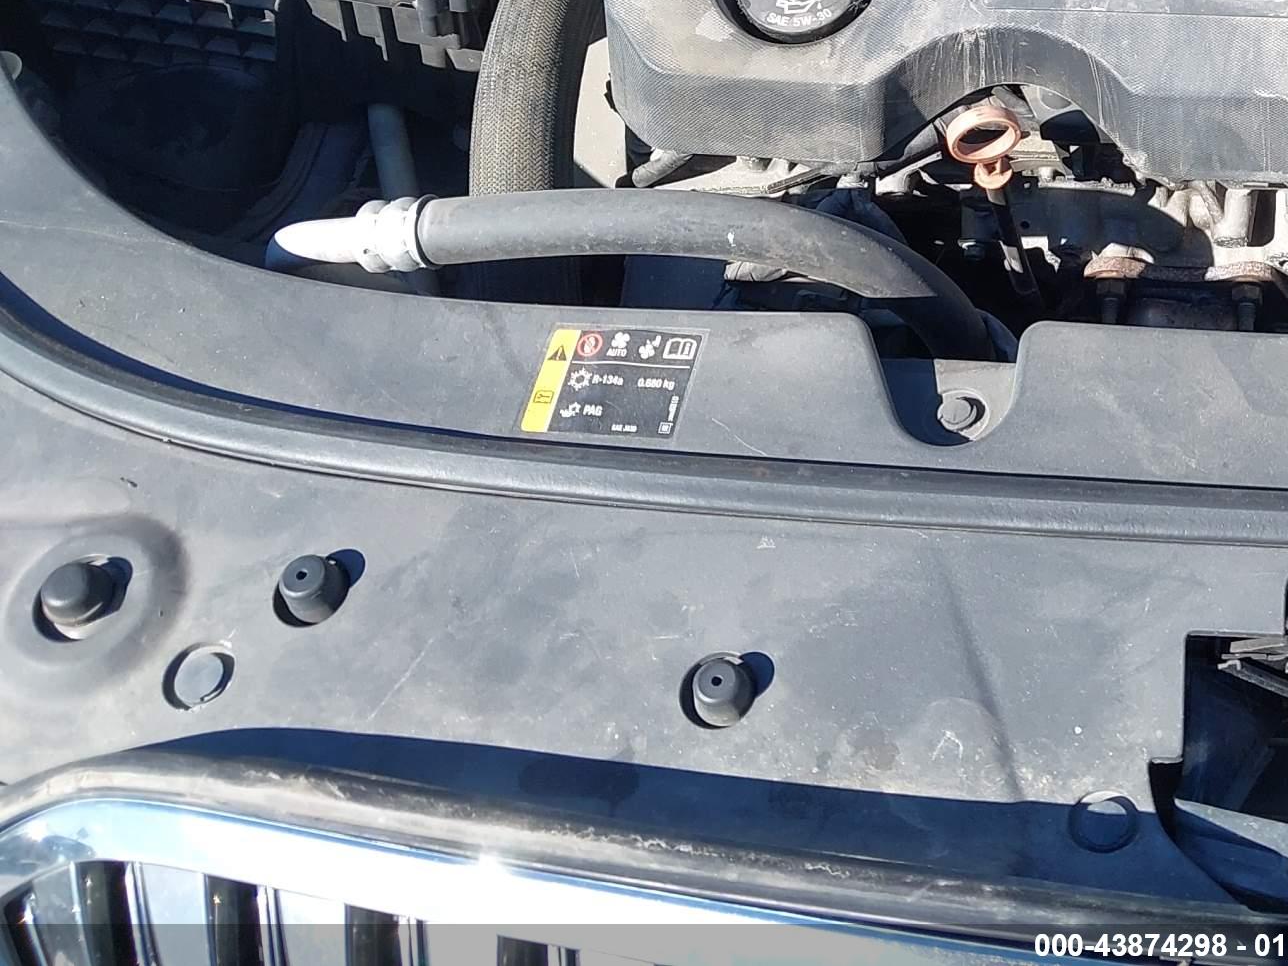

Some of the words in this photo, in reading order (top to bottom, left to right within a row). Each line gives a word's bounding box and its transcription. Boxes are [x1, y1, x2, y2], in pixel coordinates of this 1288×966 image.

[767, 12, 788, 27] SAE
[793, 8, 832, 27] 5W-30
[606, 347, 628, 357] AUTO
[592, 374, 624, 386] R-134a
[663, 379, 675, 391] kg
[583, 405, 603, 416] PAG
